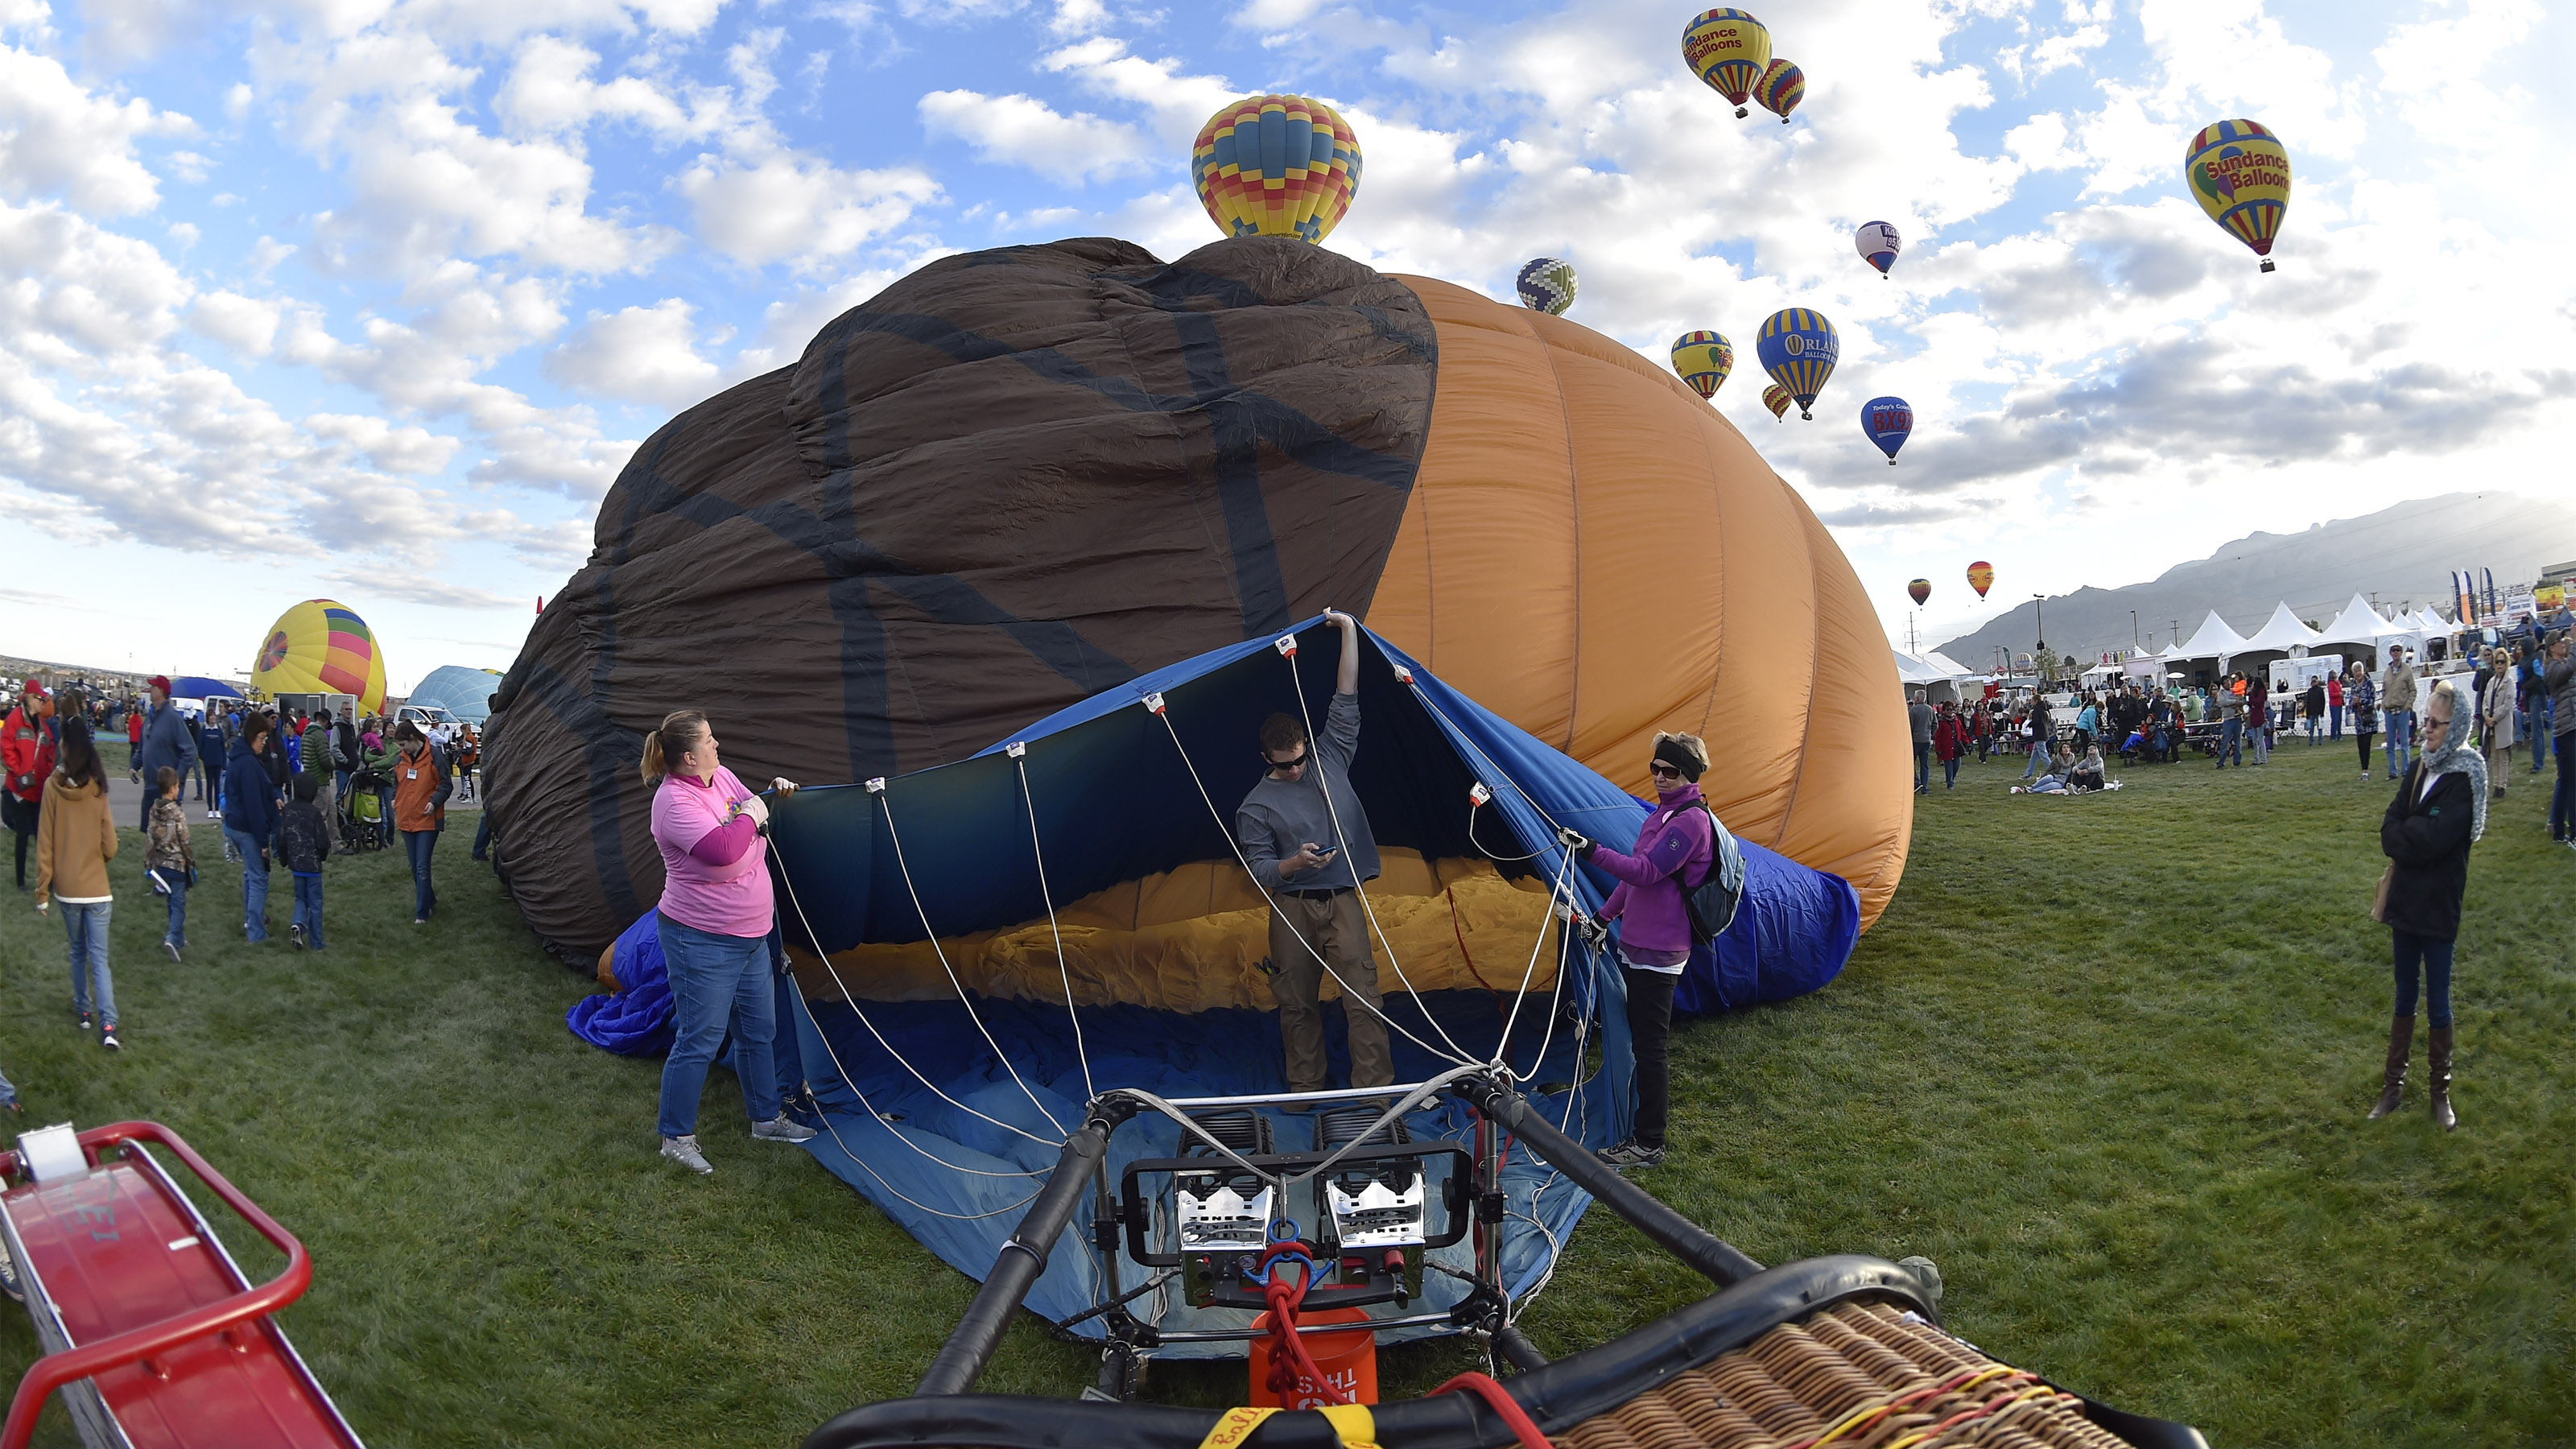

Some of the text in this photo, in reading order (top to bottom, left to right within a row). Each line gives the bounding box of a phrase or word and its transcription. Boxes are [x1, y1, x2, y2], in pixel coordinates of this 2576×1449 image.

[1683, 27, 1738, 60] Sundance
[1691, 39, 1743, 63] Balloons
[2206, 151, 2289, 179] Sundance
